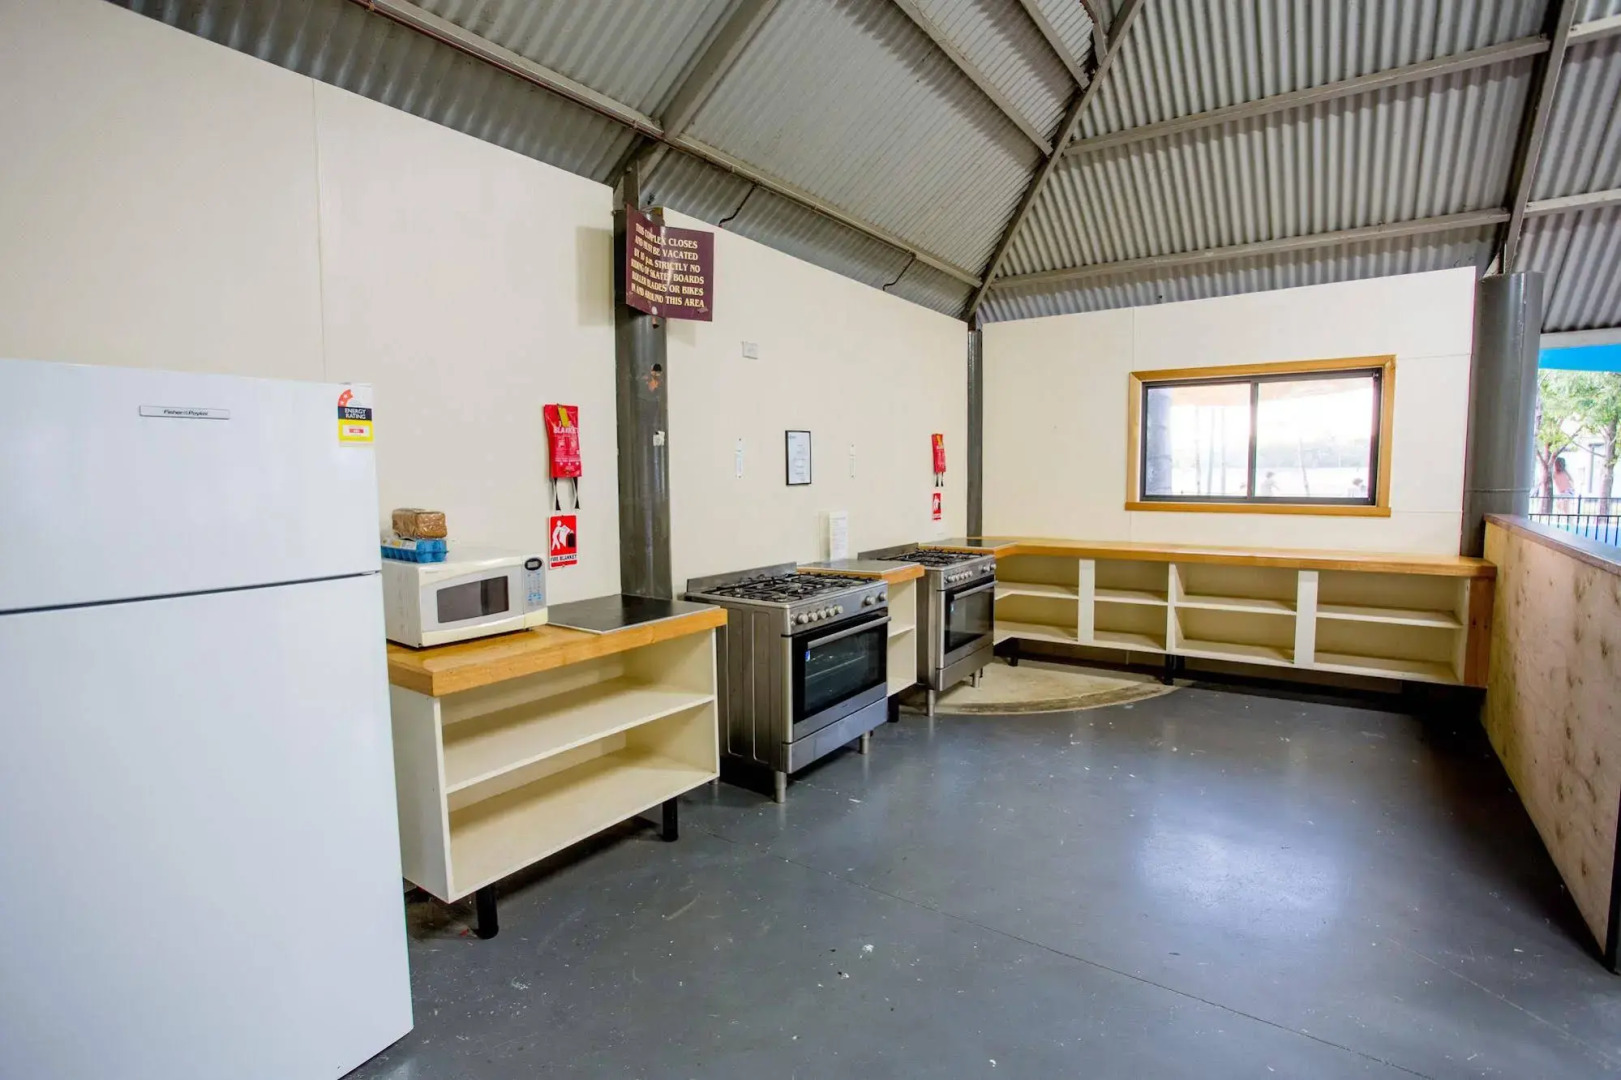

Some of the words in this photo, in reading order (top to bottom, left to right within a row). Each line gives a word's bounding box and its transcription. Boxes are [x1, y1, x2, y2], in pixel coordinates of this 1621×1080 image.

[634, 235, 643, 246] AND
[643, 240, 652, 253] MUST
[652, 246, 660, 256] BE
[662, 248, 698, 260] VACATED
[644, 229, 666, 246] COMPLEX
[668, 238, 698, 249] CLOSES
[654, 260, 688, 272] STRICTLY
[690, 264, 700, 274] NO
[646, 278, 666, 292] BLADES
[669, 284, 680, 294] OR
[682, 286, 704, 296] BIKES
[673, 274, 704, 284] BOARDS
[644, 290, 664, 304] AROUND
[665, 296, 682, 306] THIS
[684, 298, 704, 308] AREA
